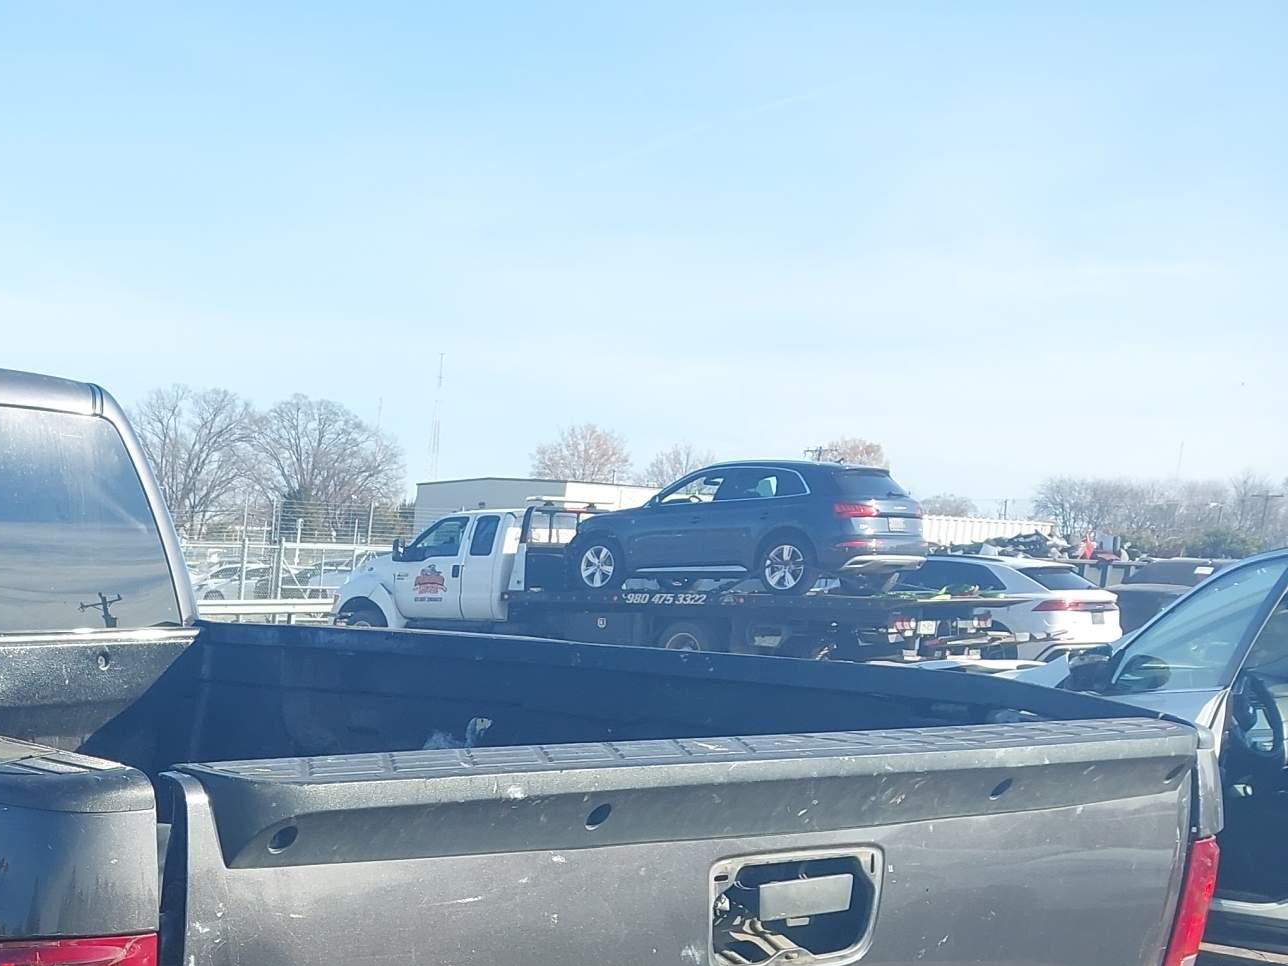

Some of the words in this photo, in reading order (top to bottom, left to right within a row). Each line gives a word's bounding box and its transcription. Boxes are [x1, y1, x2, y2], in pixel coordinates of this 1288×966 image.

[626, 593, 650, 604] 980
[651, 593, 675, 605] 475
[675, 593, 707, 605] 3322
